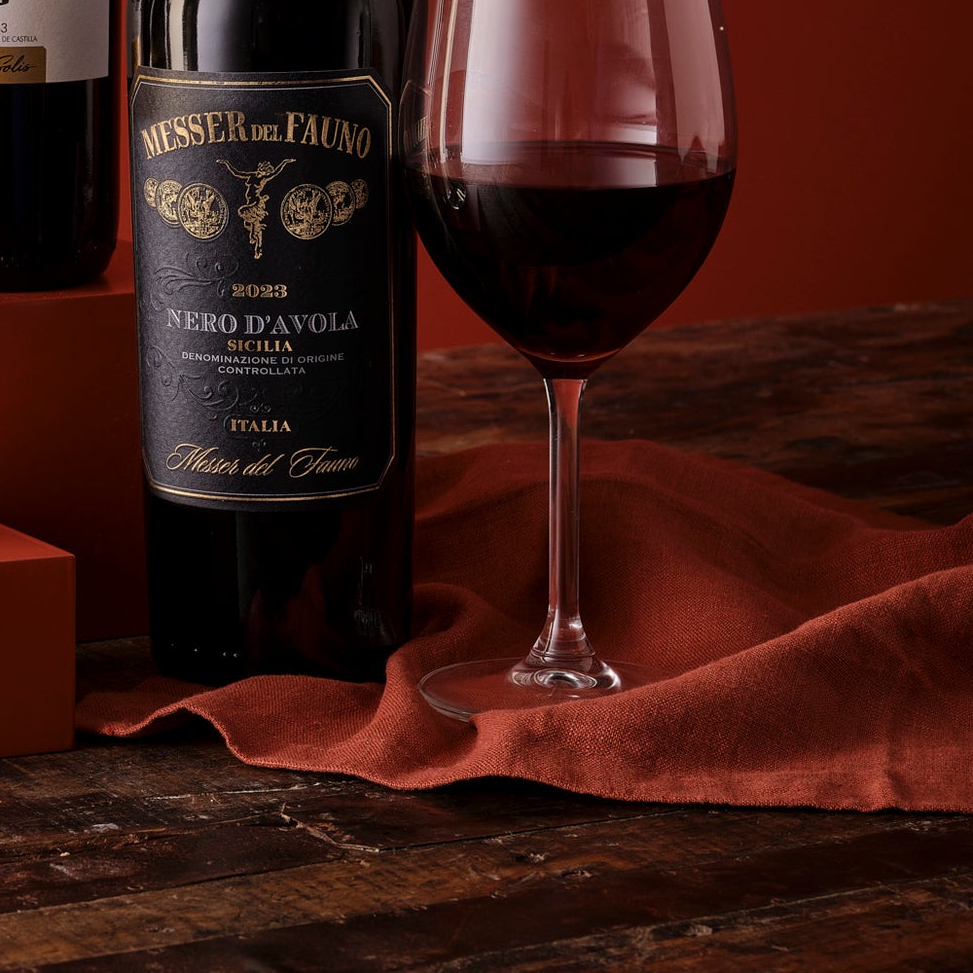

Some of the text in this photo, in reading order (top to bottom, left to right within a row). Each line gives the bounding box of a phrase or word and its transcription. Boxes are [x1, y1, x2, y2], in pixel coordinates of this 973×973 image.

[1, 35, 10, 43] DE
[11, 35, 38, 43] CASTILLA
[139, 110, 372, 161] MESSER DEL FAUNO
[230, 282, 289, 299] 2023
[166, 307, 360, 336] NERO D'AVOLA
[226, 338, 294, 354] SICILIA
[181, 351, 346, 365] DENOMINAZIONE DI ORIGINE
[217, 365, 307, 376] CONTROLLATA
[229, 418, 293, 434] ITALIA
[165, 442, 360, 479] Messer del Fauno
